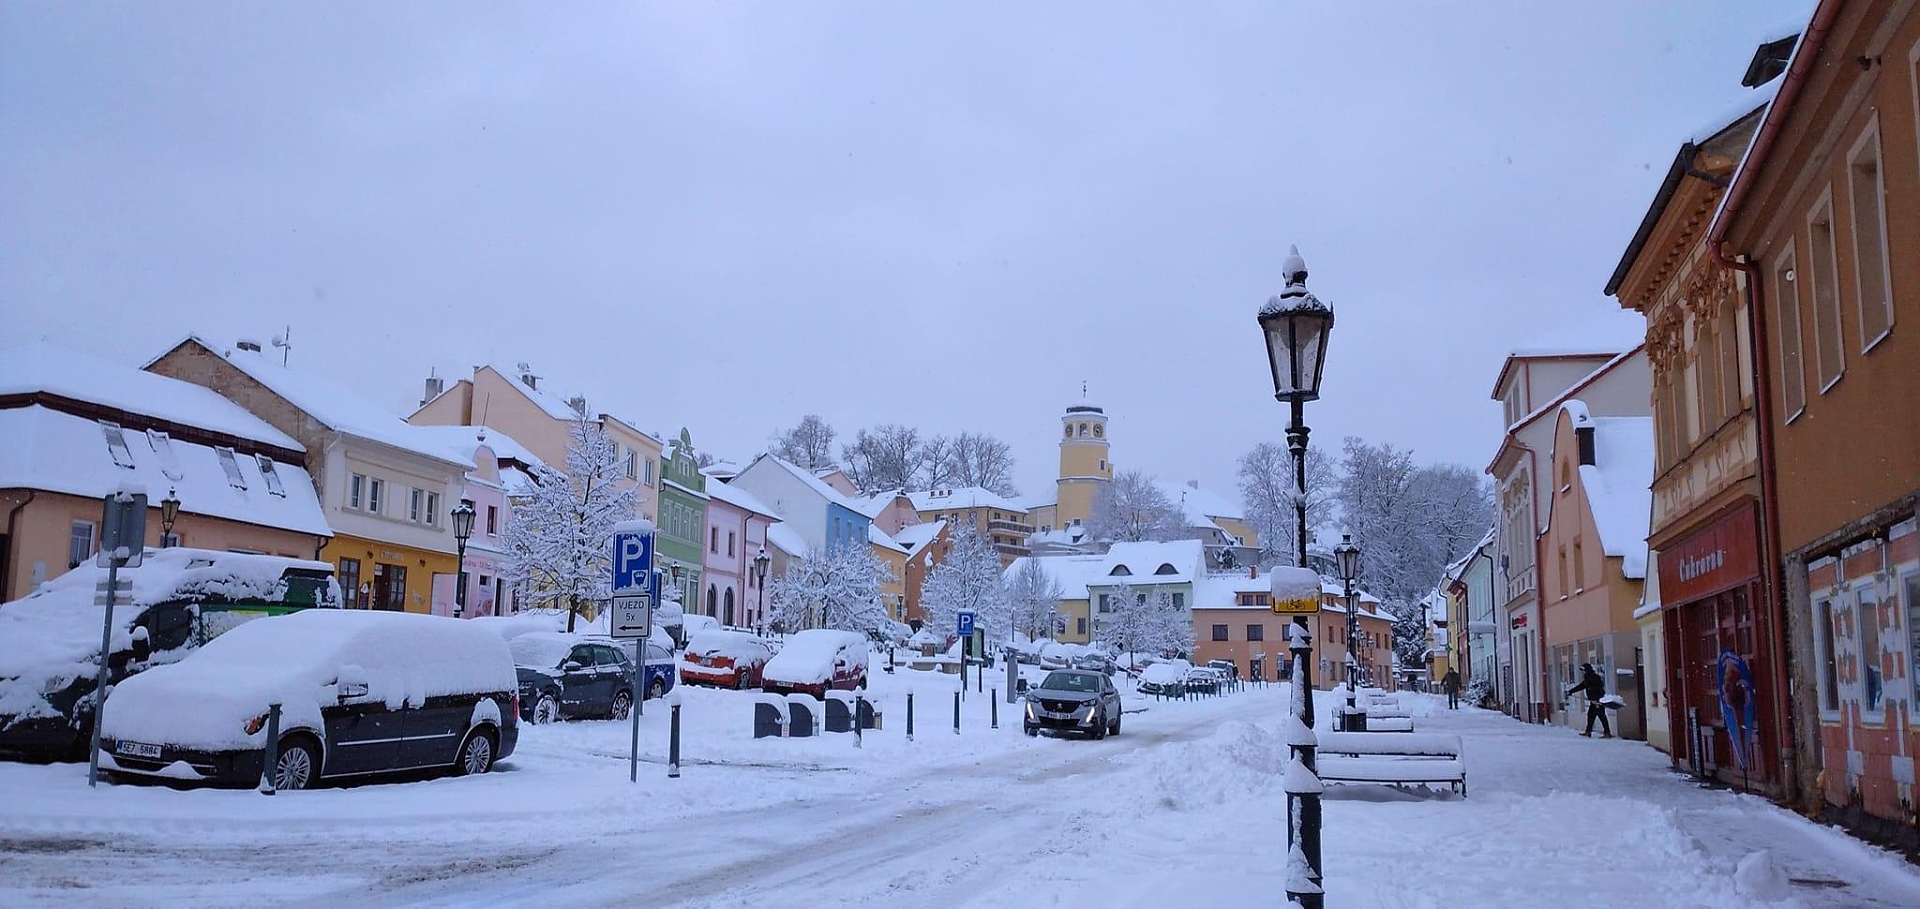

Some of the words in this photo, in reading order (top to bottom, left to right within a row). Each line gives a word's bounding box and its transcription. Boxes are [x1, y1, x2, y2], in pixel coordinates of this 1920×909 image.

[621, 539, 643, 573] P
[618, 600, 645, 610] VJEZD
[625, 612, 636, 621] 5x
[961, 615, 971, 629] P
